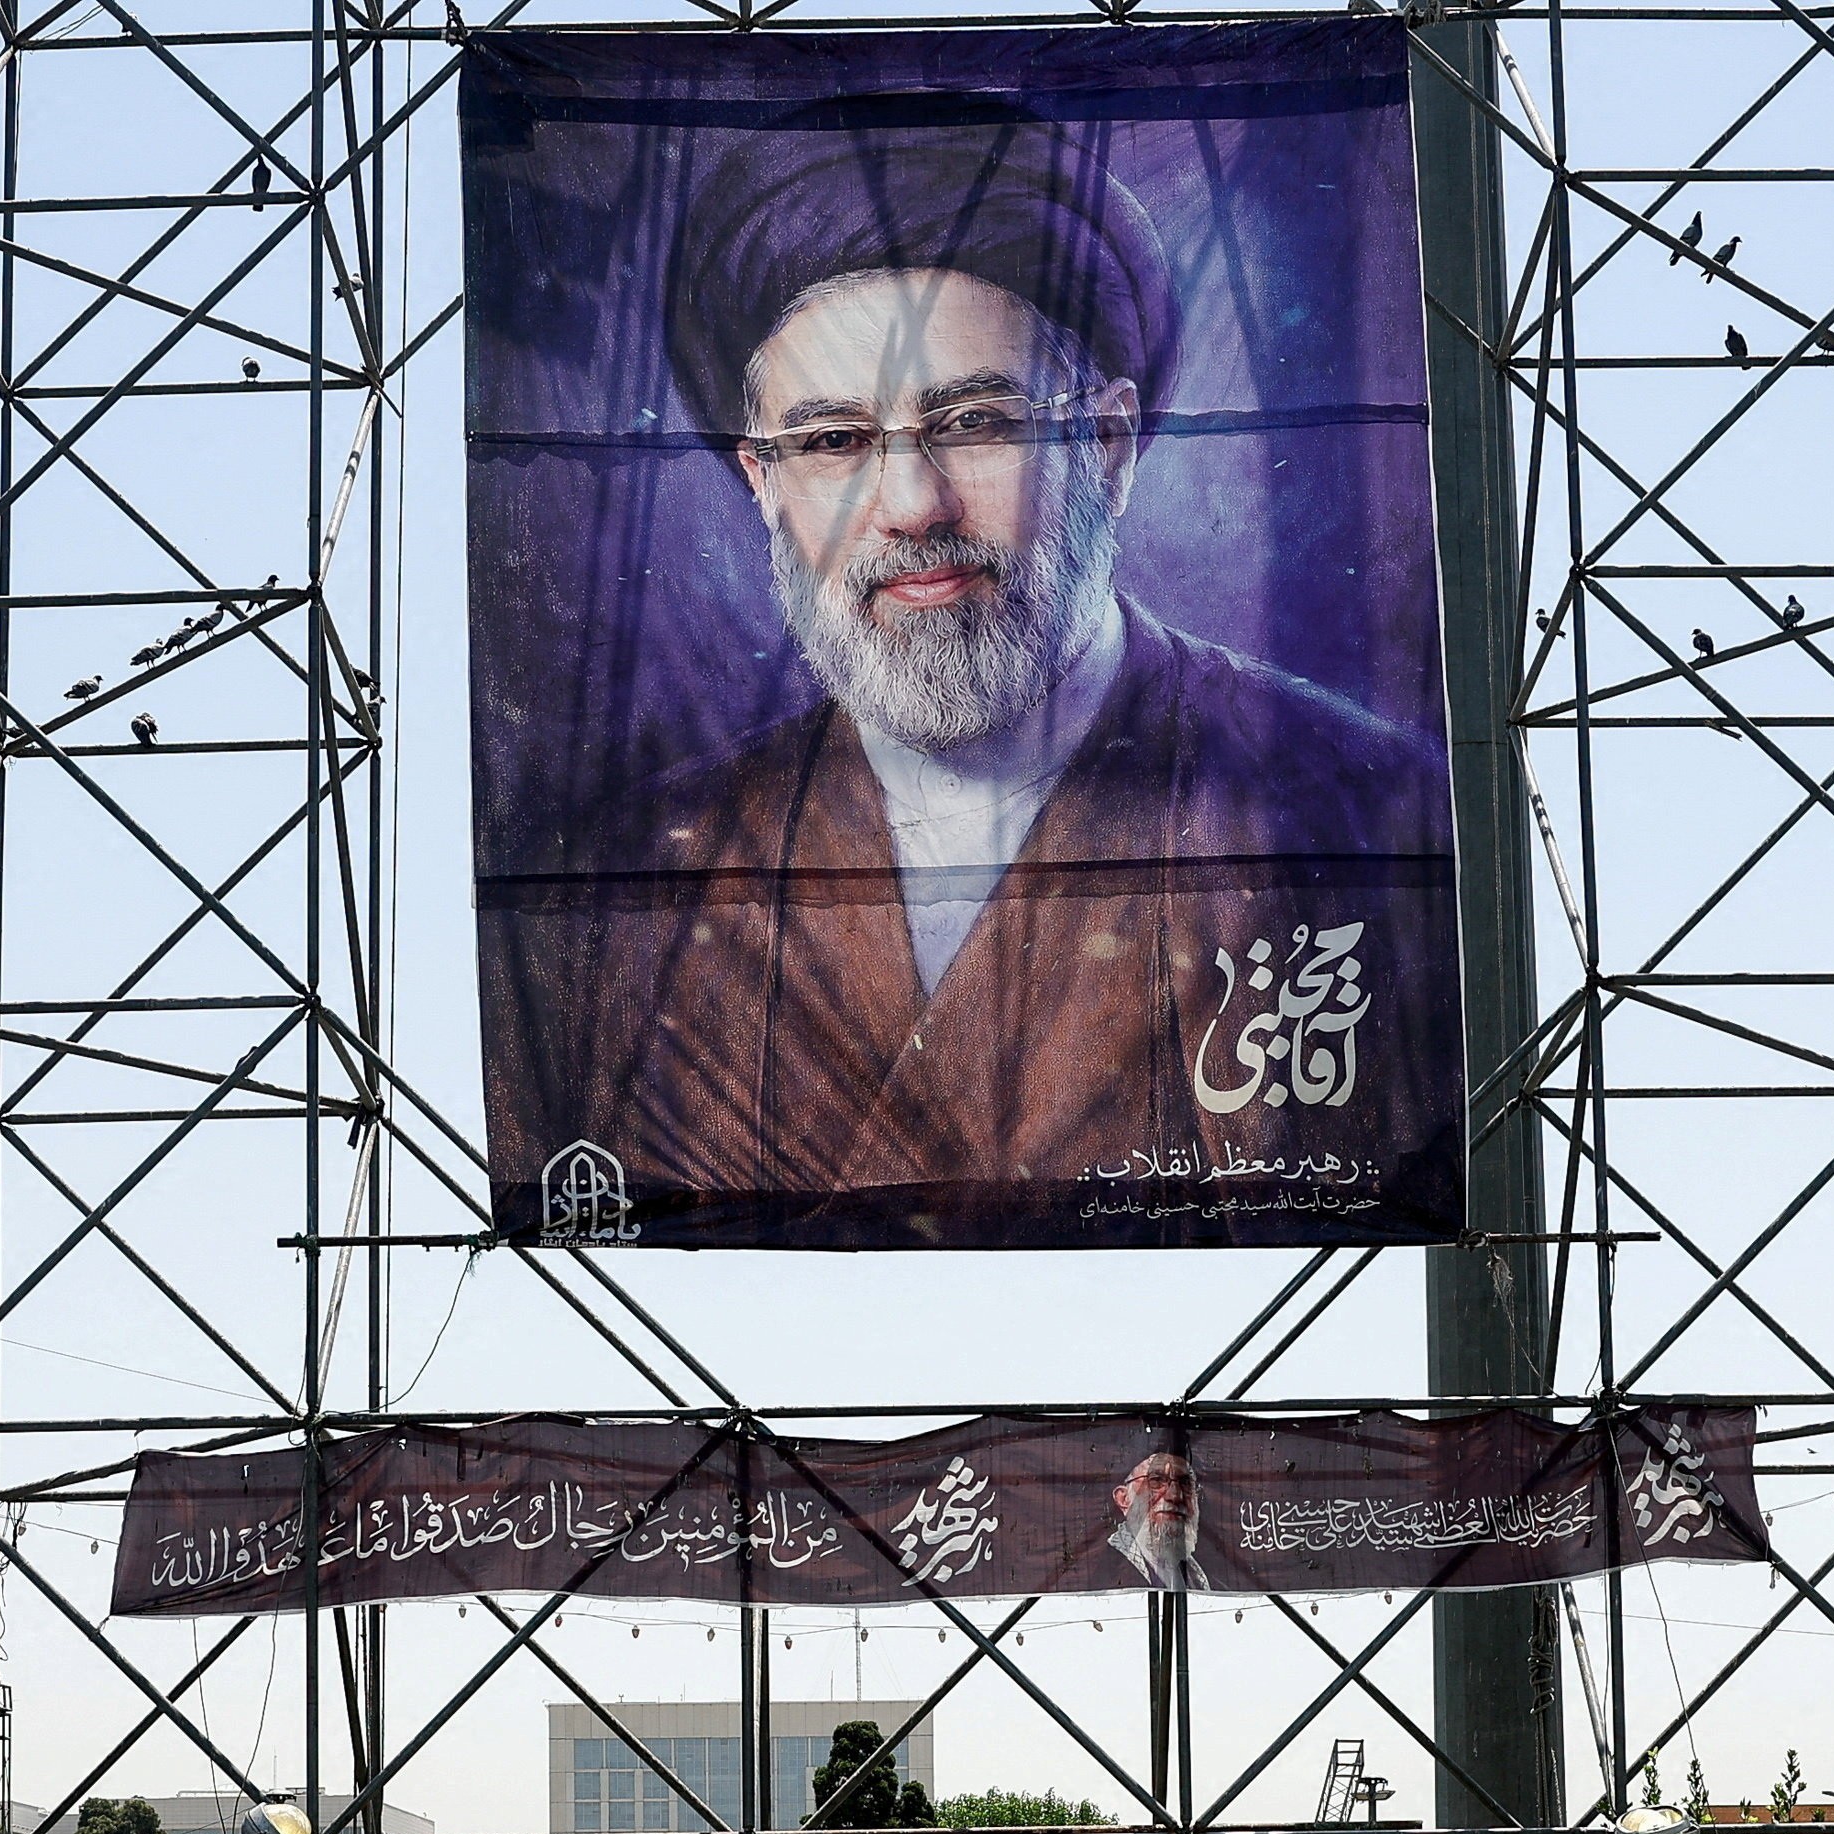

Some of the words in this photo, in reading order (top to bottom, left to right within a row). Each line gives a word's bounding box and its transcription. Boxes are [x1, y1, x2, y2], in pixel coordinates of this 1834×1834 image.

[1097, 1141, 1201, 1187] انقلاب
[1199, 1142, 1286, 1185] معظم
[1280, 1152, 1360, 1184] رهبر
[1323, 1197, 1381, 1215] حضرت
